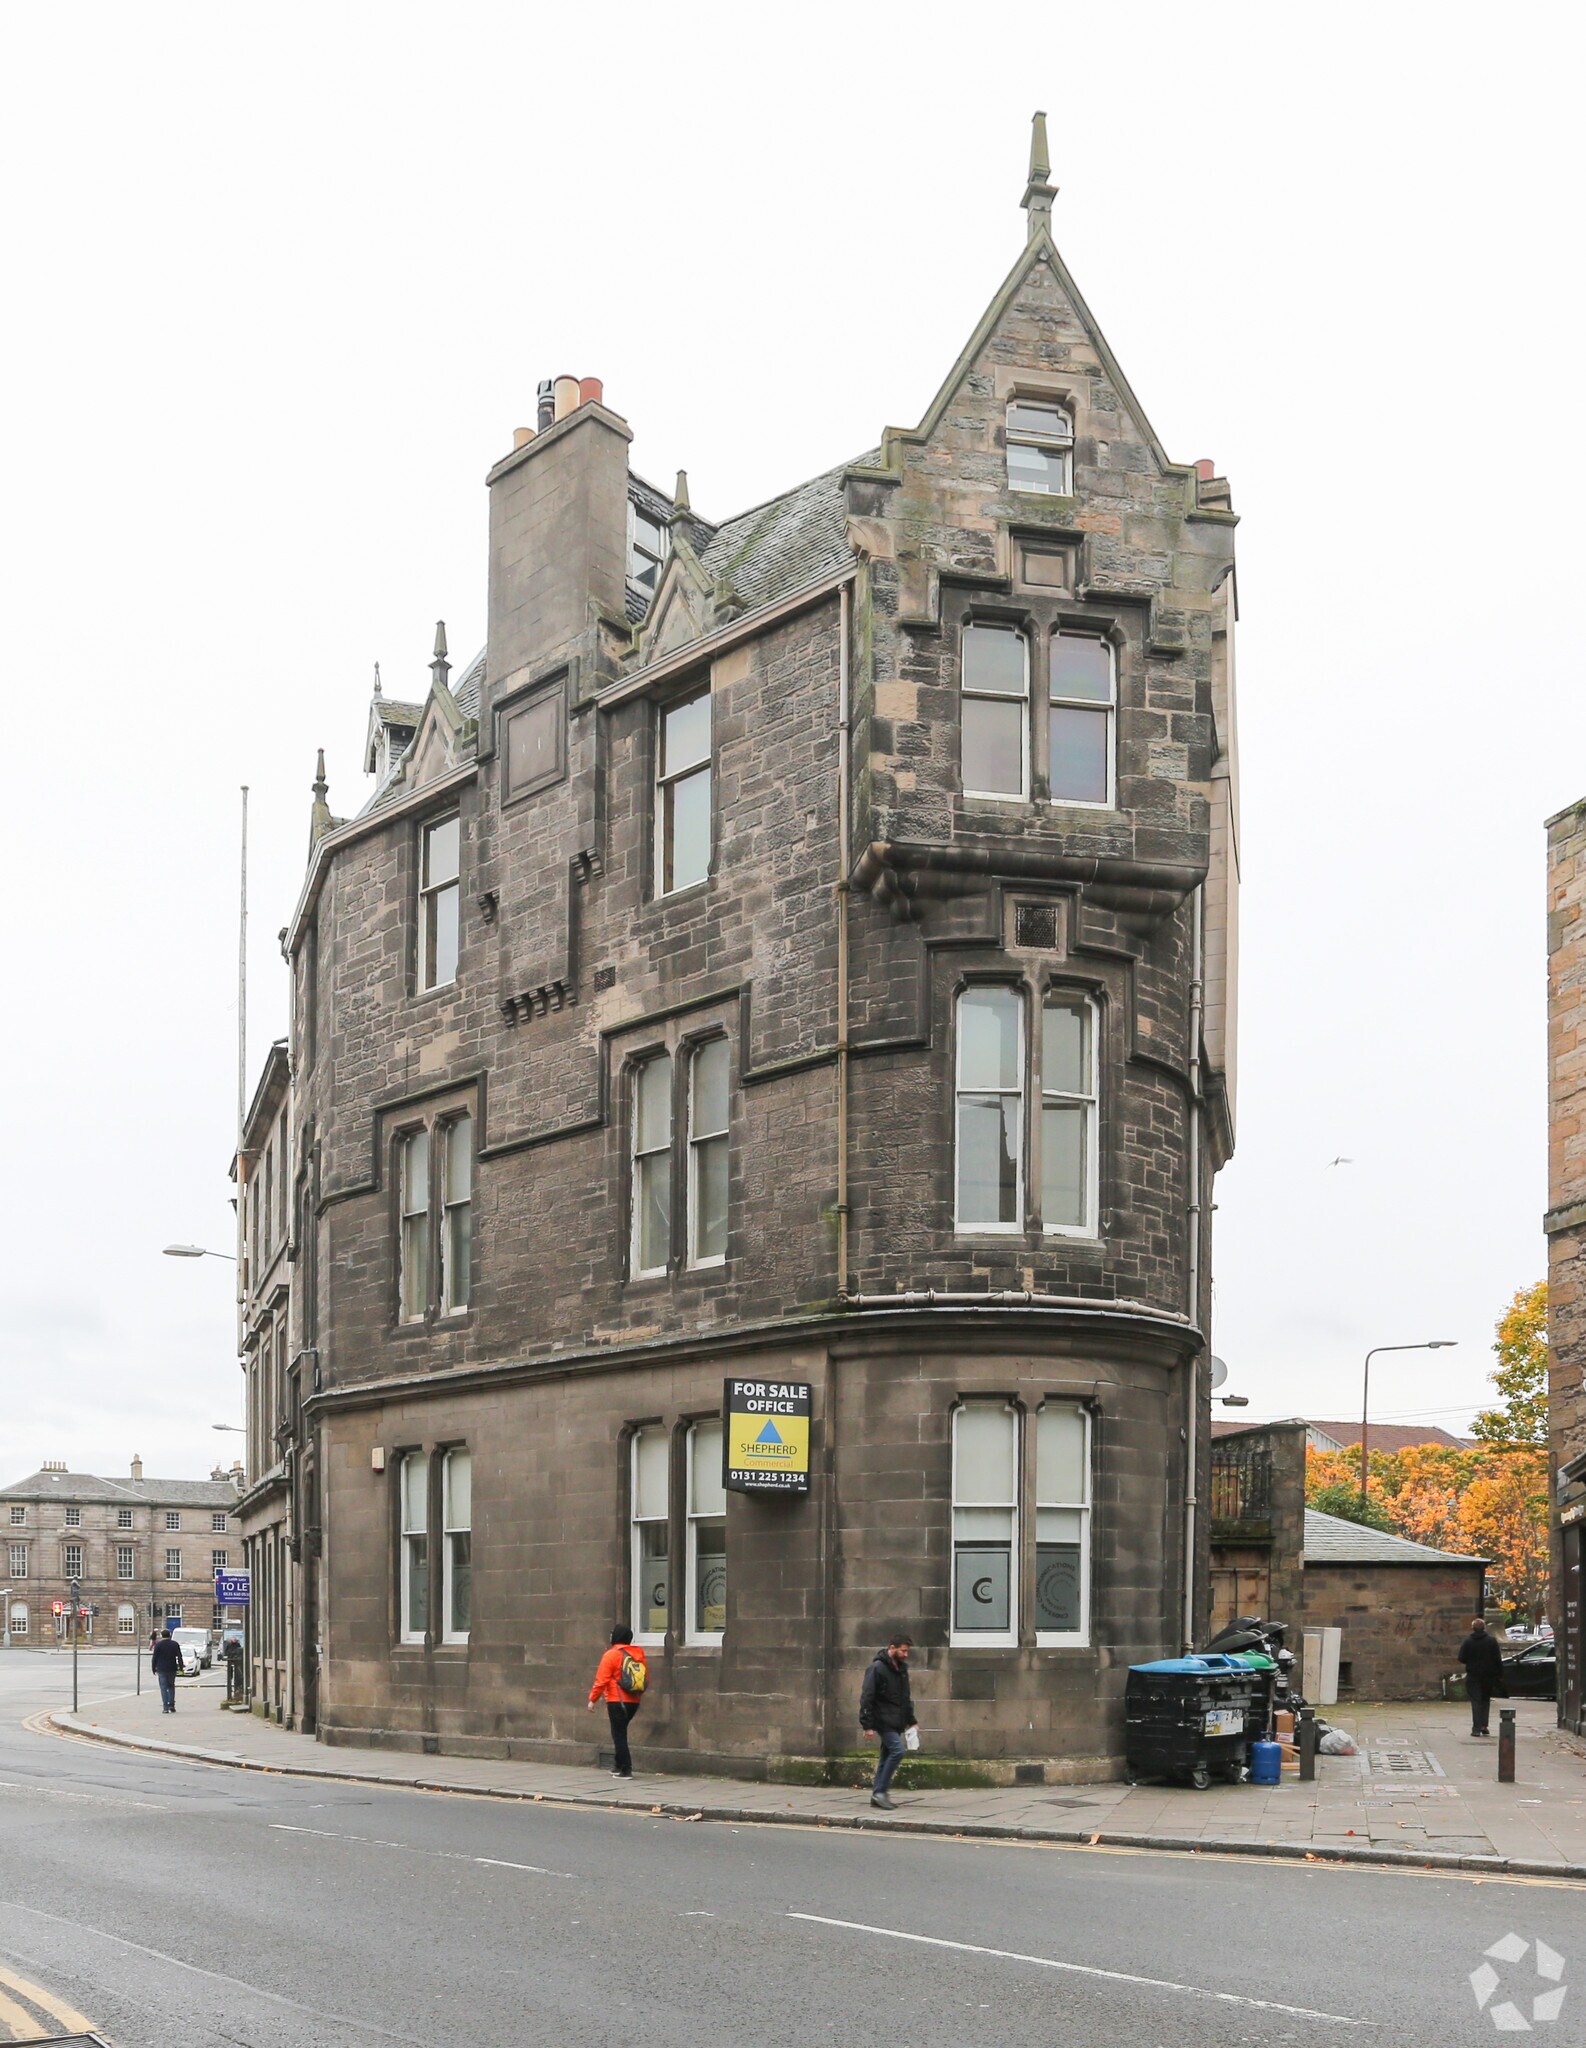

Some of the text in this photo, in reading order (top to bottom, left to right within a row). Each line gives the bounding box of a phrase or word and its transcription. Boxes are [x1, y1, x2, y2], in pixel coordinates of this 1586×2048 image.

[734, 1382, 808, 1399] FOR SALE
[746, 1399, 794, 1413] OFFICE
[740, 1443, 798, 1455] SHEPHERD
[743, 1458, 793, 1468] Commercial
[731, 1471, 805, 1482] 0131 225 1234
[221, 1582, 235, 1591] TO
